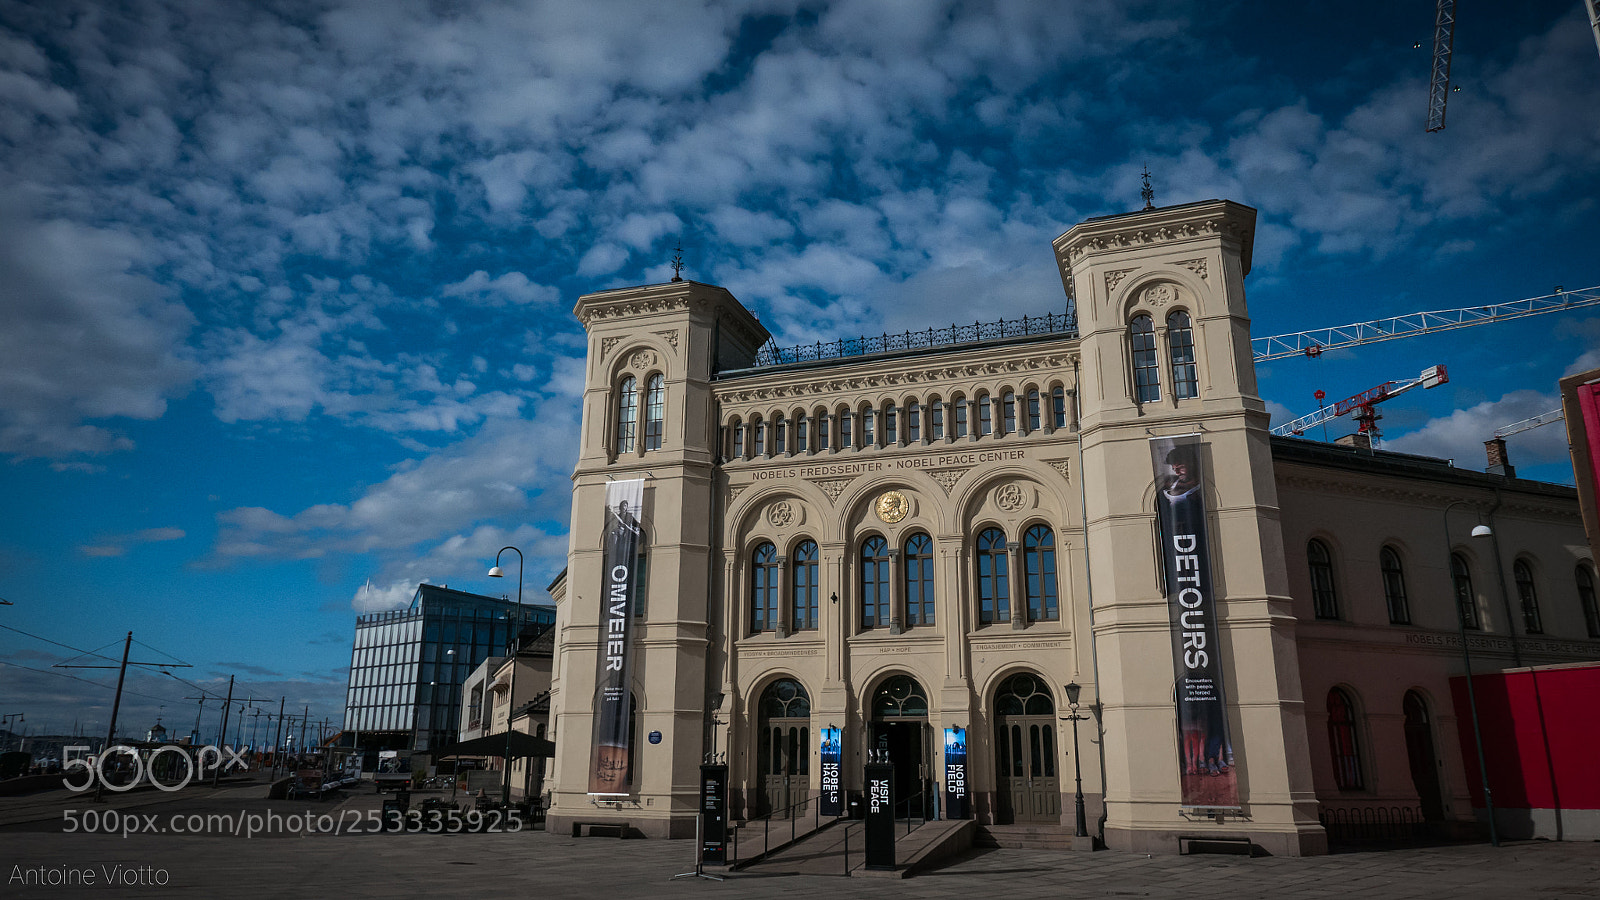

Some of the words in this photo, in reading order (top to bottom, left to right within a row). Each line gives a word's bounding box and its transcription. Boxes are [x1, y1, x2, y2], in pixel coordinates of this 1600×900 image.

[752, 469, 796, 480] NOBELS
[800, 462, 882, 477] FREDSSENTER
[896, 458, 935, 469] NOBEL
[939, 454, 975, 466] PEACE
[979, 450, 1025, 462] CENTER
[1173, 534, 1209, 669] DETOURS
[606, 565, 628, 671] OMVEIER
[1405, 634, 1443, 645] NOBELS
[822, 763, 831, 791] HAGE
[830, 763, 839, 803] NOBELS
[880, 779, 889, 805] VISIT
[947, 764, 956, 793] FIELD
[956, 764, 965, 799] NOBEL
[870, 779, 880, 814] PEACE
